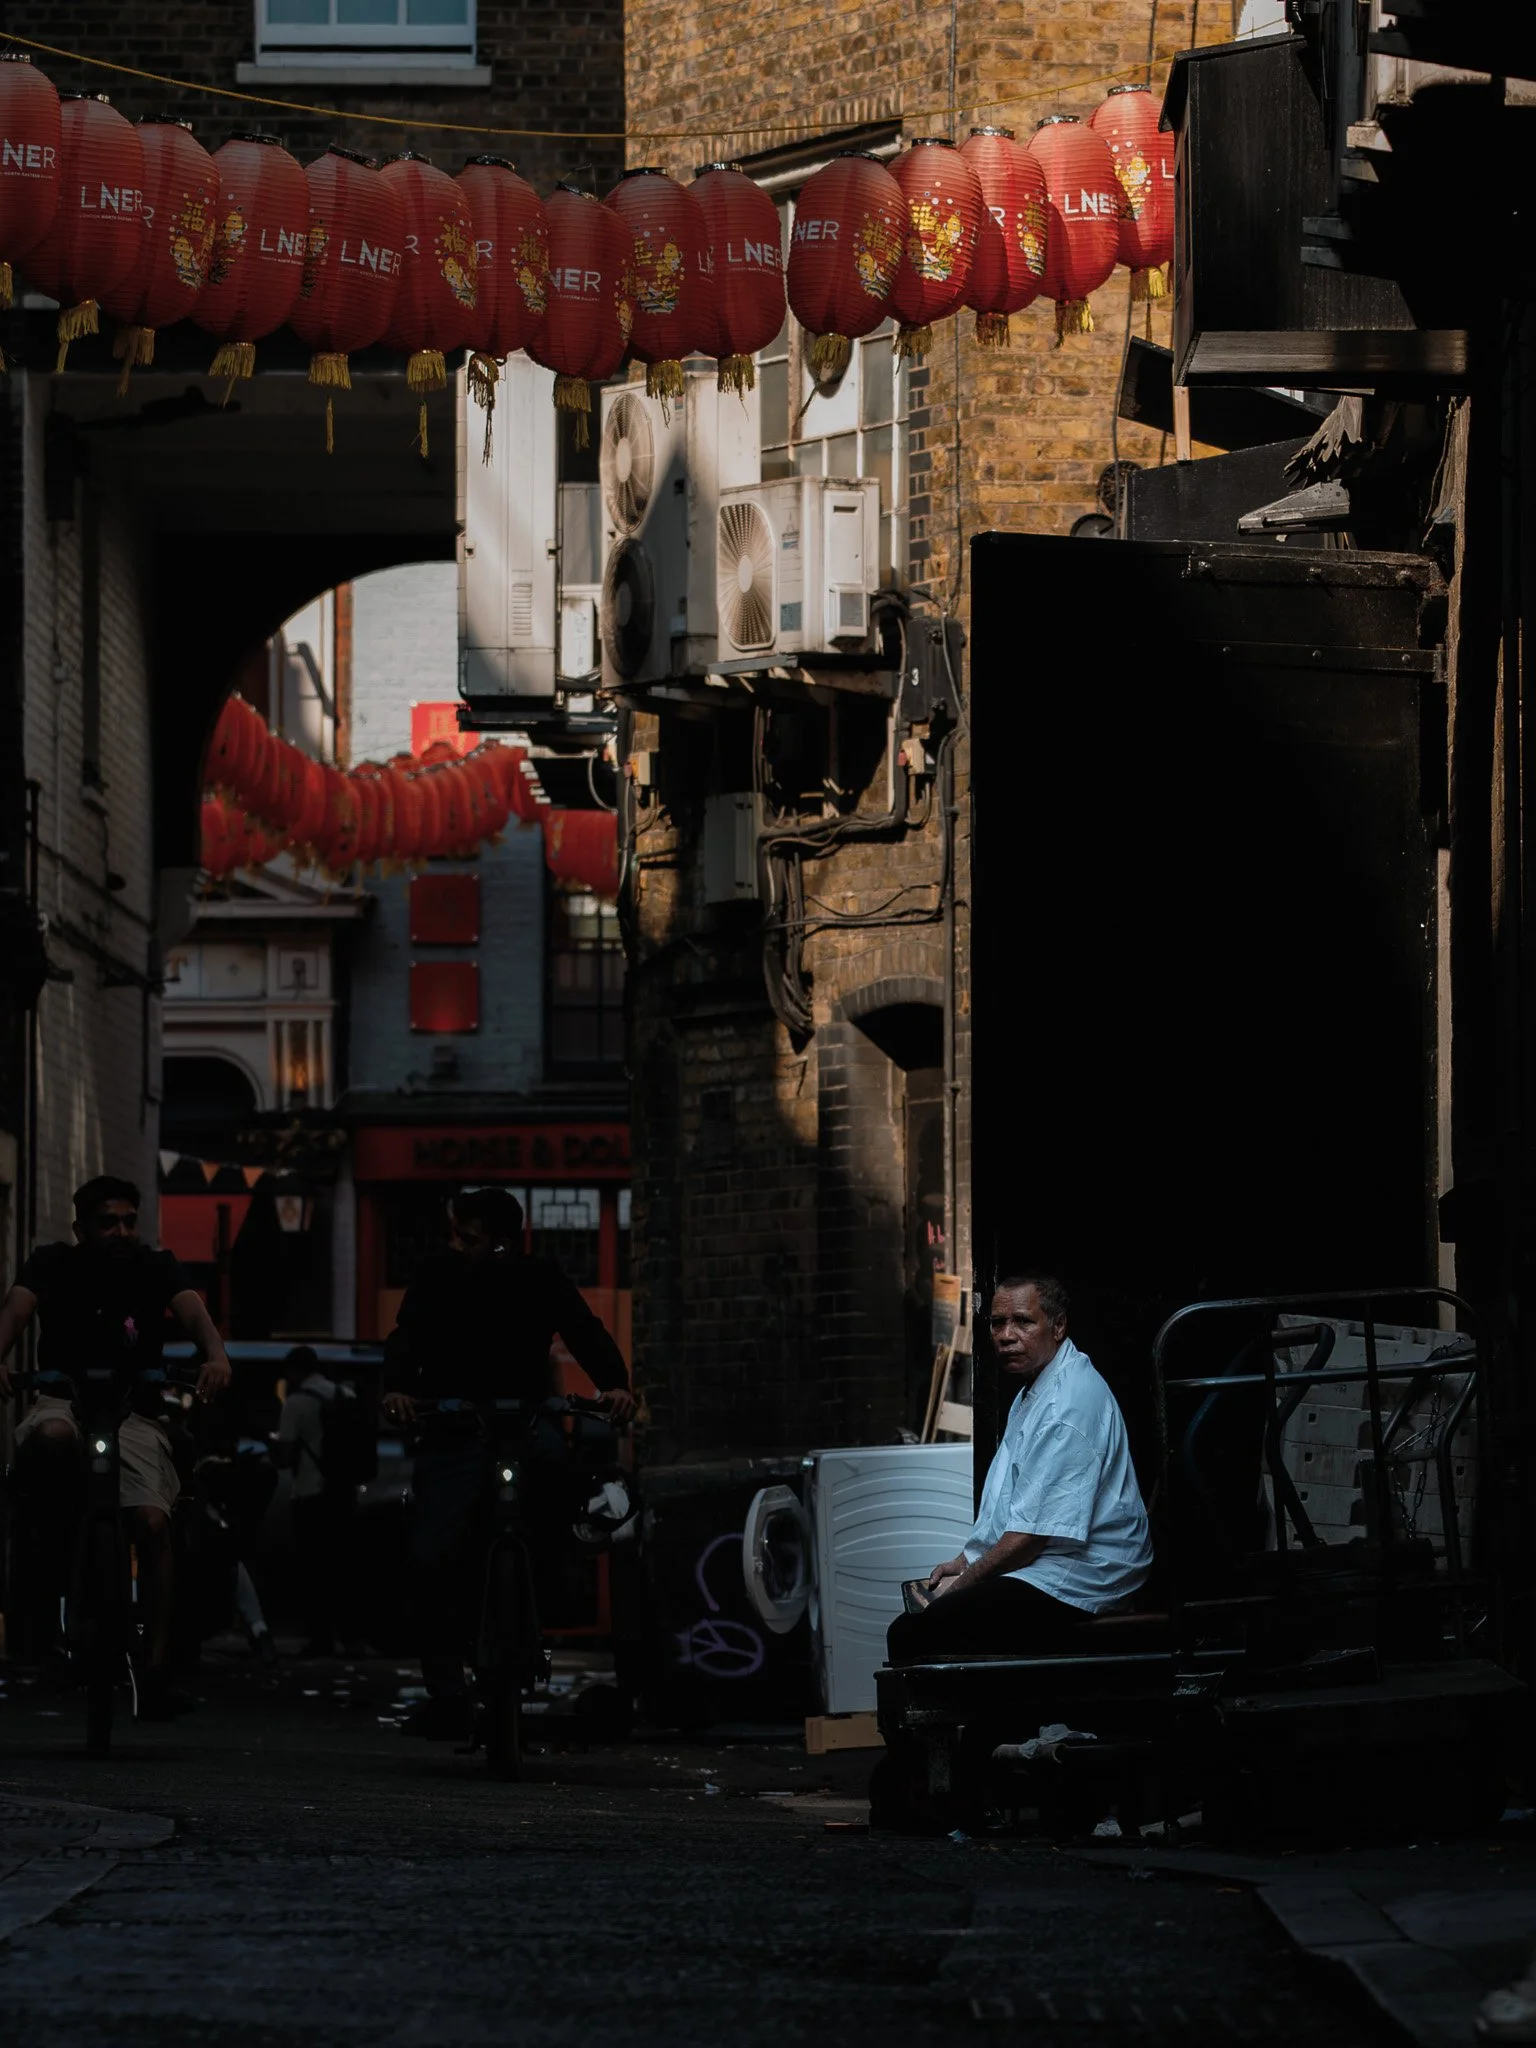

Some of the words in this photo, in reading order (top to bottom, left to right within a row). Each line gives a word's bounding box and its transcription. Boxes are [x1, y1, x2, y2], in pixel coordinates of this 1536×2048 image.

[81, 182, 144, 214] LNER
[260, 225, 307, 257] LNE
[727, 238, 784, 270] LNER
[341, 239, 402, 277] LNER
